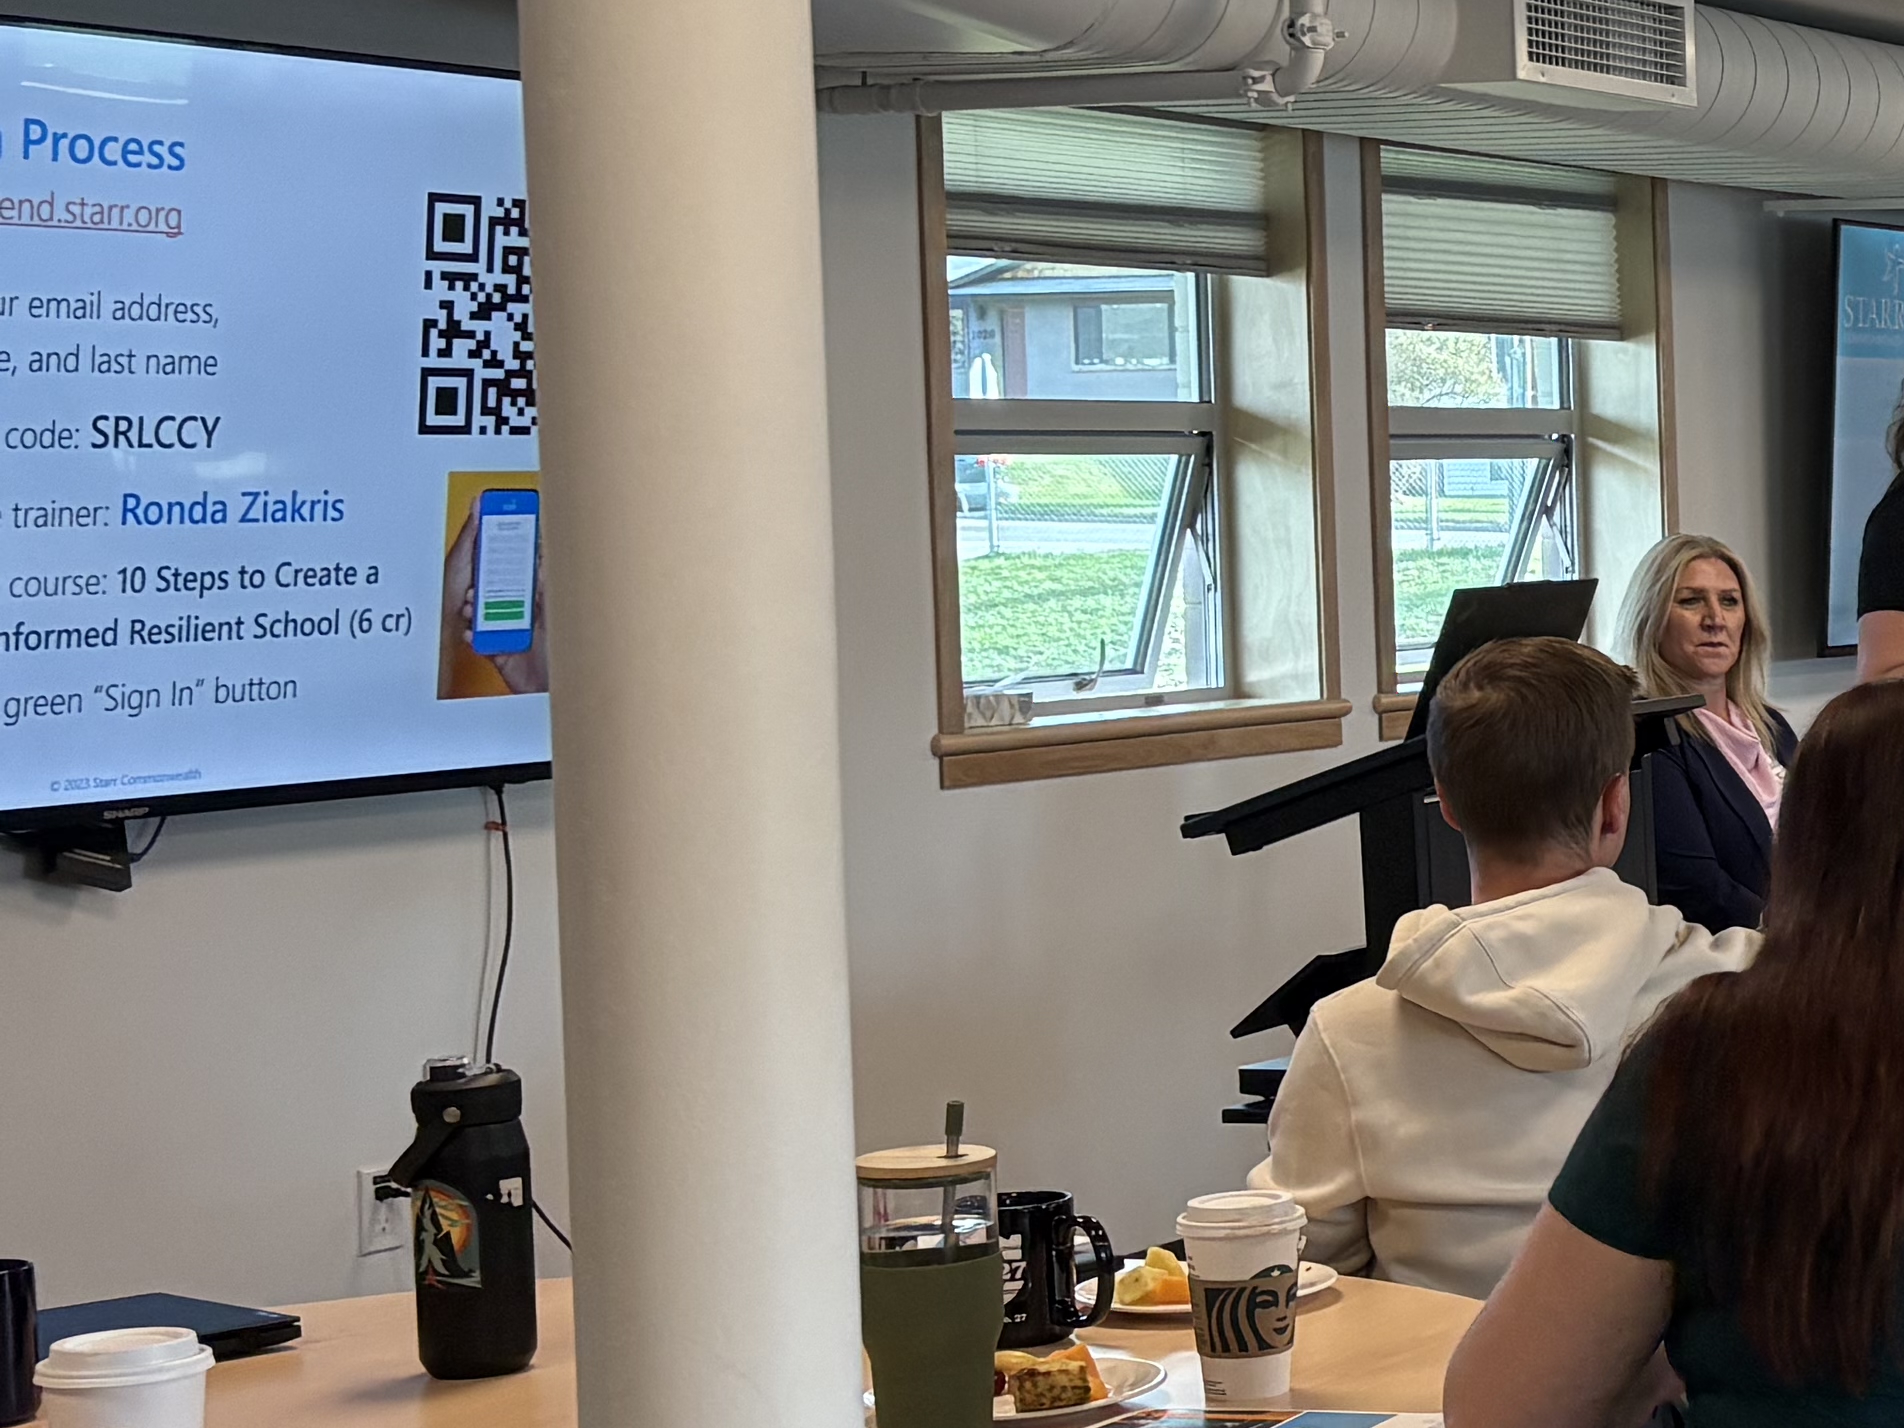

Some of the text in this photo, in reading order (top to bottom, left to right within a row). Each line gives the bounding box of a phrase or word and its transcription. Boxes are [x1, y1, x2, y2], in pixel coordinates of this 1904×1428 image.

[22, 117, 187, 171] Process
[0, 190, 183, 239] end.starr.org
[28, 290, 101, 320] email
[112, 292, 219, 329] address,
[1844, 295, 1904, 330] STARR
[28, 343, 80, 373] and
[91, 344, 136, 375] last
[145, 352, 218, 376] name
[4, 414, 222, 450] code: SRLCCY
[12, 488, 346, 529] trainer: Ronda Ziakris
[8, 560, 380, 599] course: 10 Steps to Create a
[129, 613, 245, 646] Resilient
[252, 607, 340, 640] School
[348, 608, 373, 639] (6
[380, 606, 413, 637] cr)
[3, 690, 83, 726] green
[213, 675, 298, 705] button
